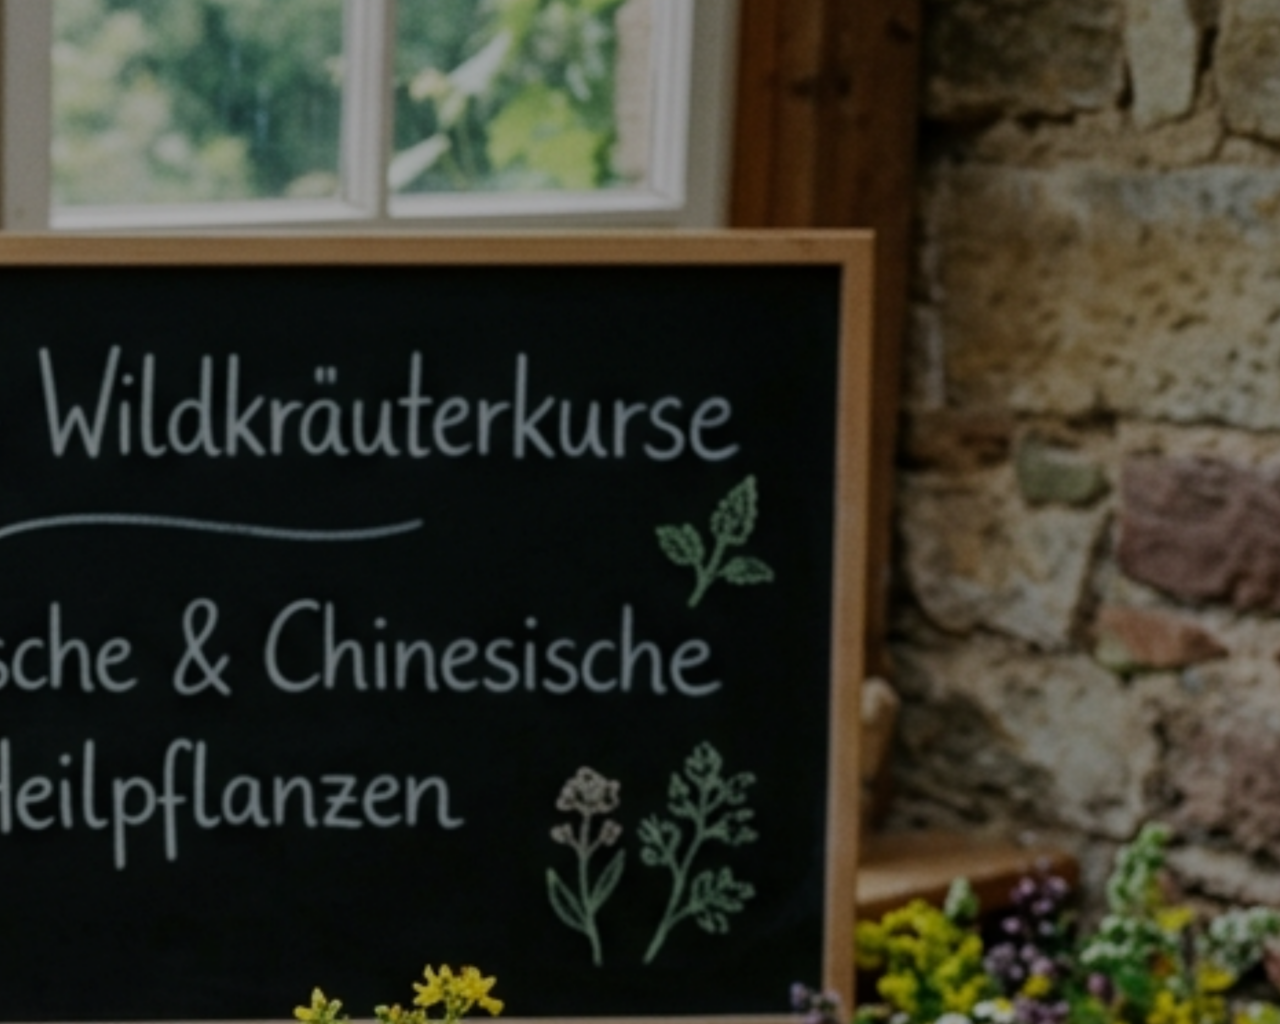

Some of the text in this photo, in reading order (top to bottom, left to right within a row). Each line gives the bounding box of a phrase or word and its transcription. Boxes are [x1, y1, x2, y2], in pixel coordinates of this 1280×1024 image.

[39, 346, 737, 460] Wildkräuterkurse
[174, 599, 230, 695] &
[264, 600, 720, 696] Chinesische
